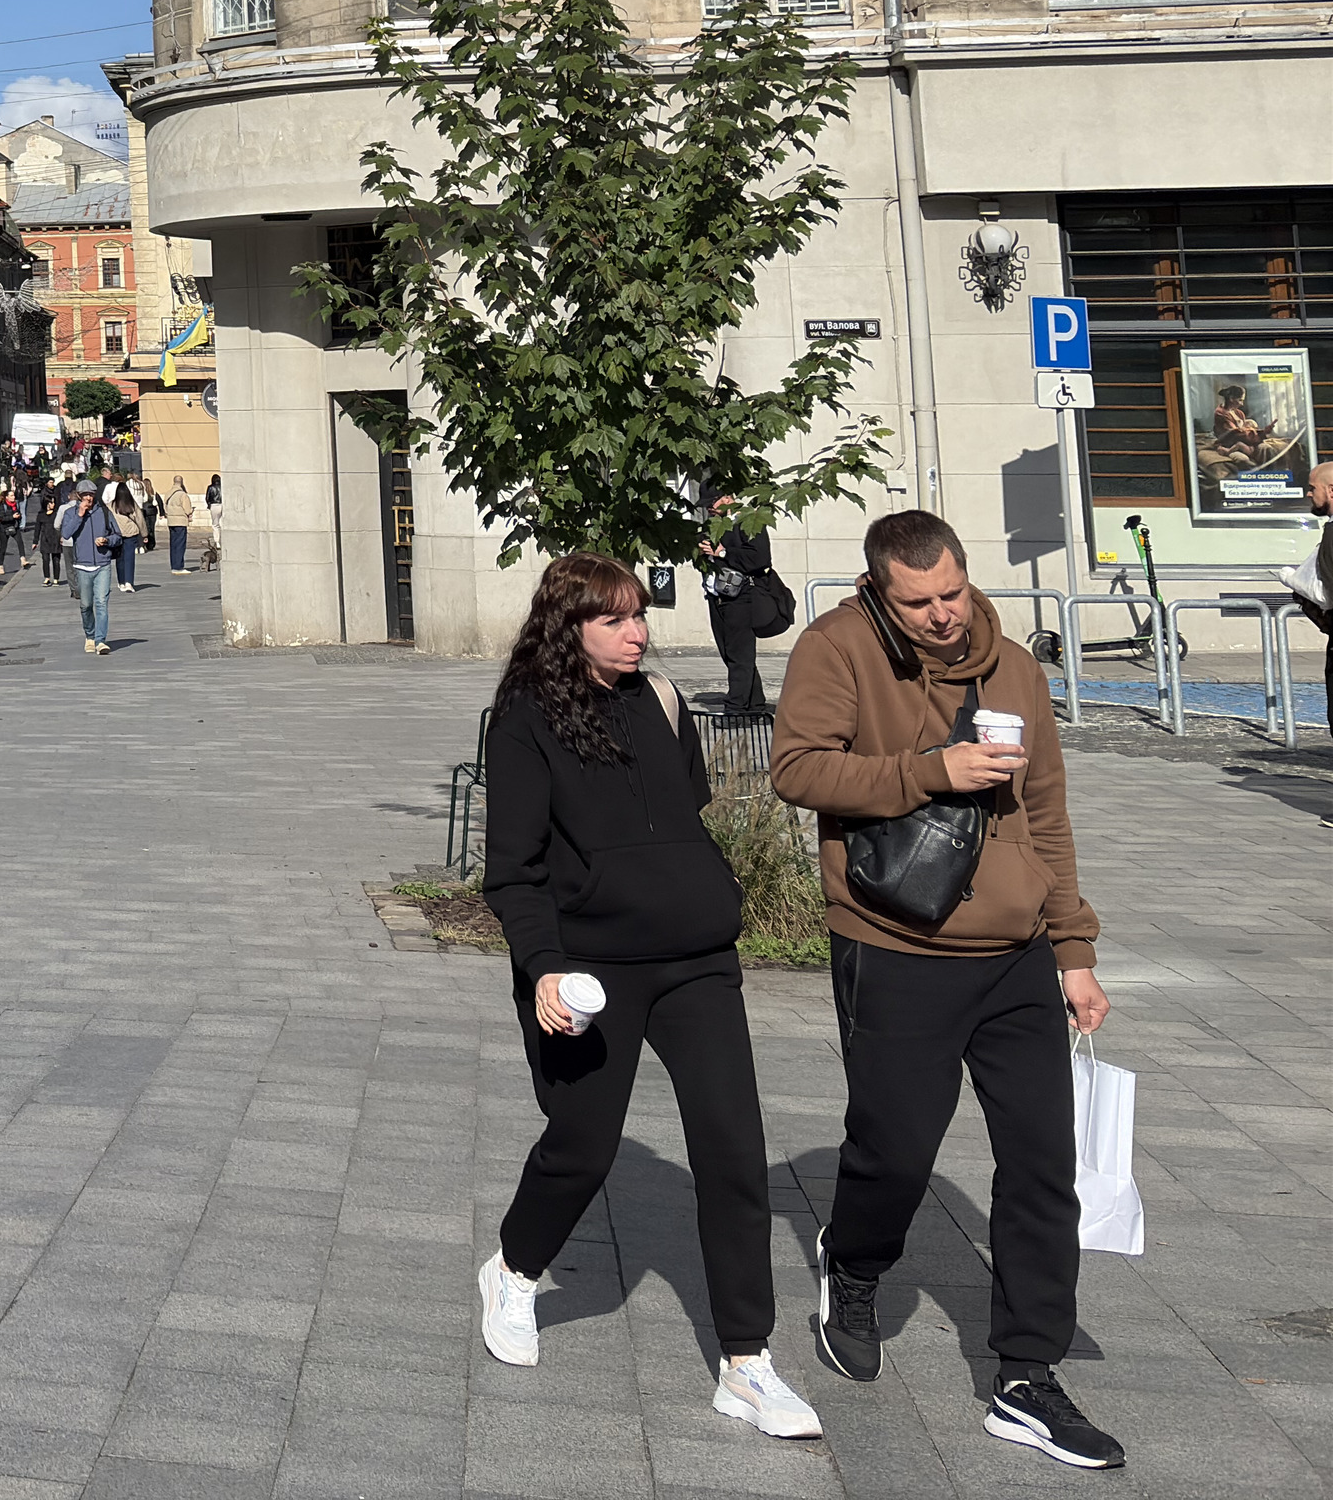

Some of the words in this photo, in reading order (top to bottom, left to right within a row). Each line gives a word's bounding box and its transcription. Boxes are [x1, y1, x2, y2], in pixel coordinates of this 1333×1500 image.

[809, 322, 825, 330] вул.
[827, 321, 860, 330] Валова
[1047, 304, 1078, 361] P
